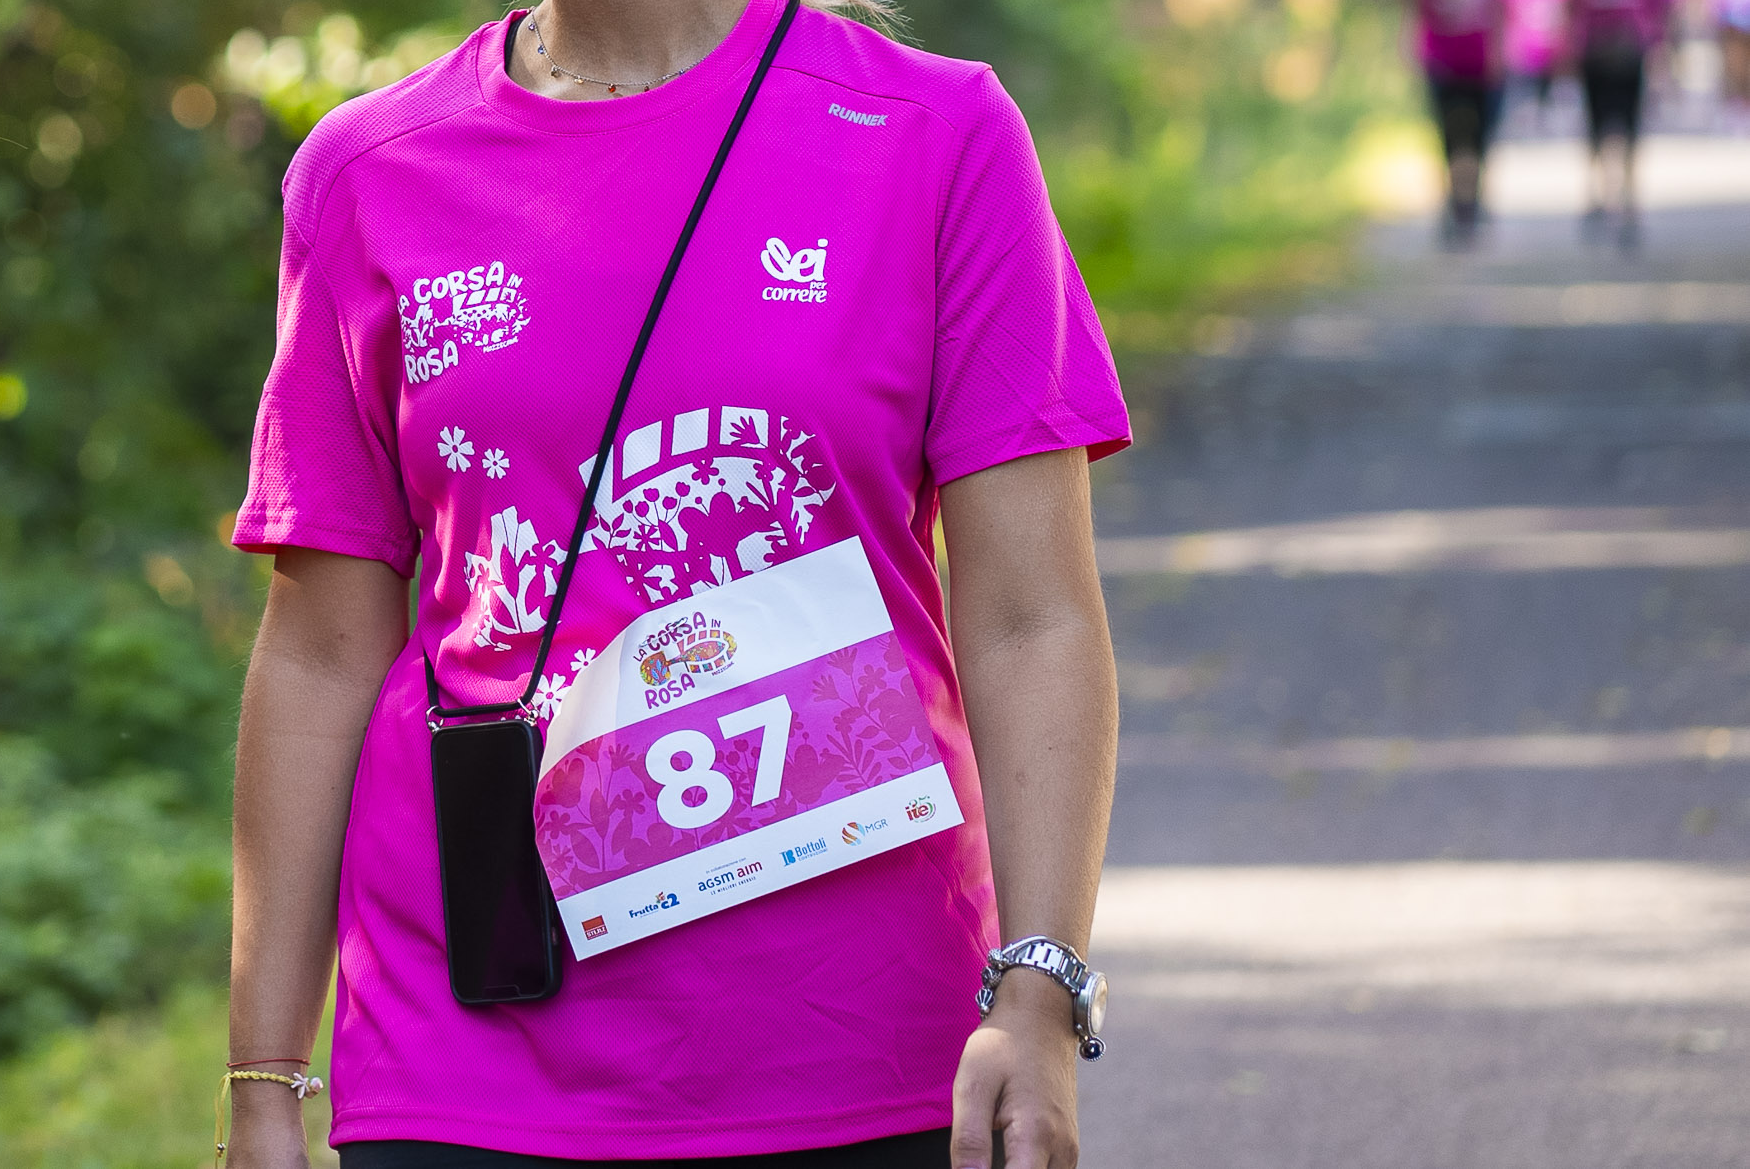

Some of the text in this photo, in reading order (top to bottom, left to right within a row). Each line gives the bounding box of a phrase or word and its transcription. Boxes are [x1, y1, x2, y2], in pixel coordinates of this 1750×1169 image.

[828, 103, 888, 127] RUNNEK
[413, 261, 504, 304] CORSA
[762, 286, 827, 303] correre
[404, 339, 459, 384] ROSA
[633, 611, 721, 662] LA CORSA IN
[644, 673, 696, 709] ROSA
[645, 694, 793, 830] 87
[864, 818, 888, 833] MGR
[794, 837, 827, 857] Bottoli
